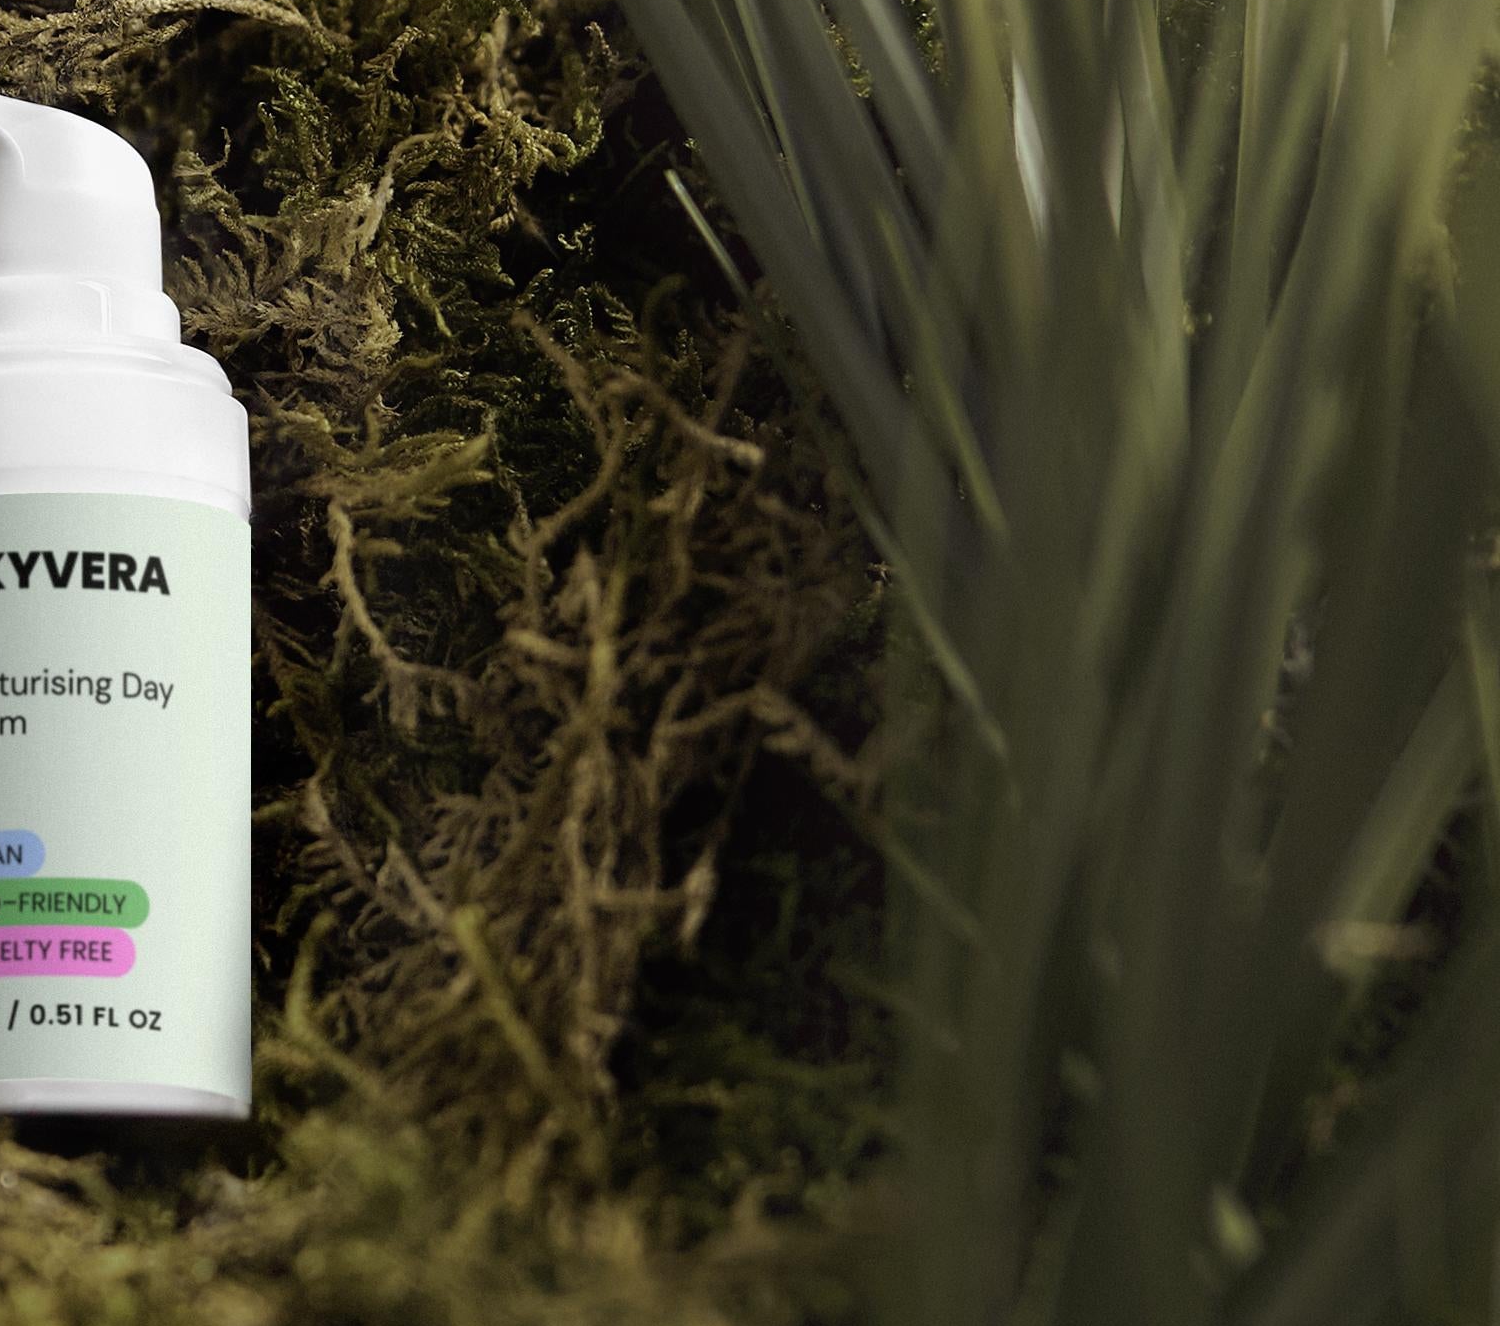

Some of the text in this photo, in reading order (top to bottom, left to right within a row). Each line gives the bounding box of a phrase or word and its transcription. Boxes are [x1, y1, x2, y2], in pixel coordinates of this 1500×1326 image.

[122, 671, 175, 710] Day
[59, 939, 114, 963] FREE
[29, 1004, 84, 1027] 0.51
[93, 1006, 119, 1028] FL
[128, 1009, 163, 1032] OZ
